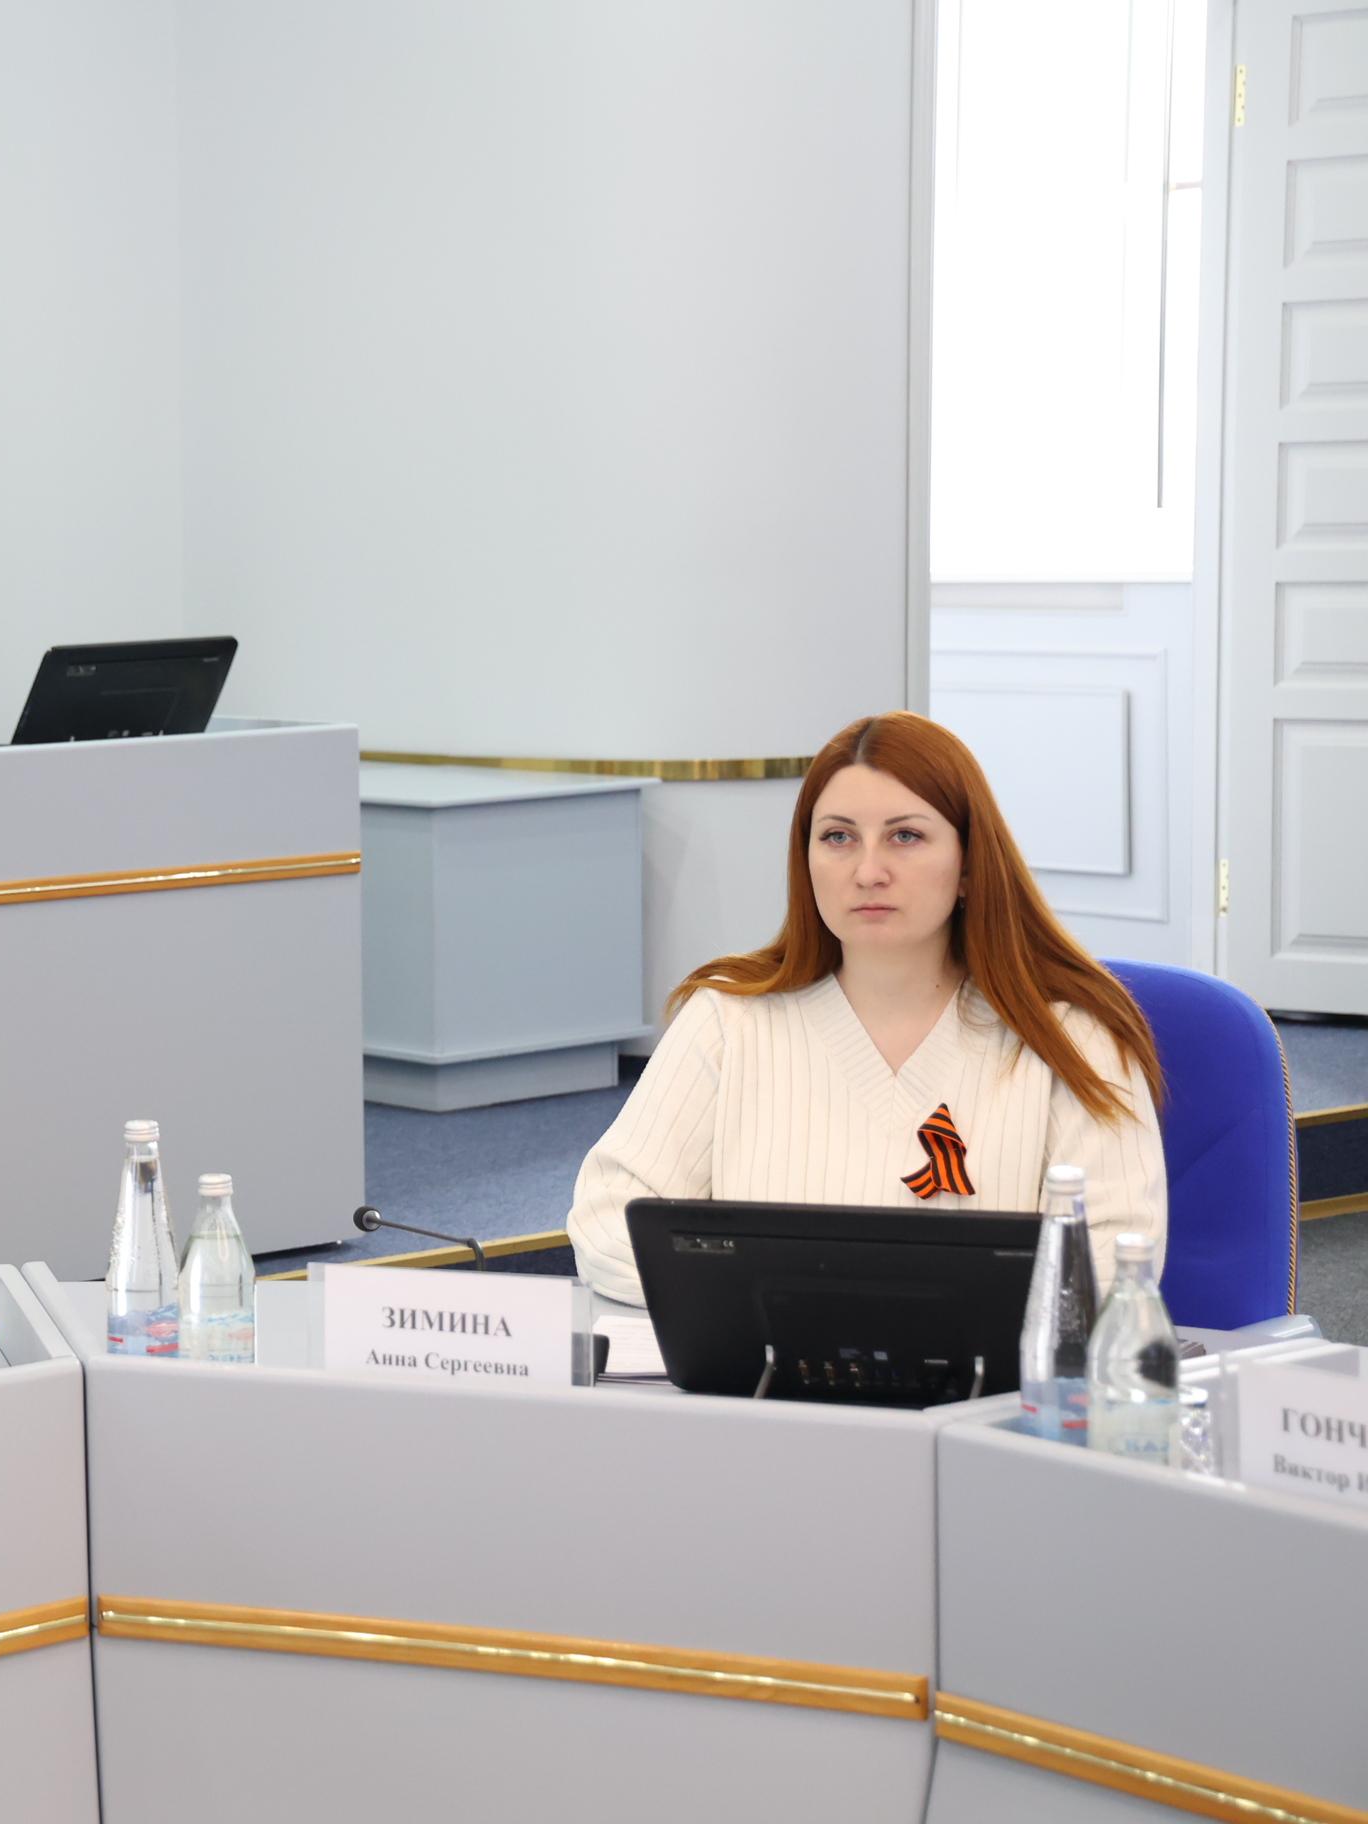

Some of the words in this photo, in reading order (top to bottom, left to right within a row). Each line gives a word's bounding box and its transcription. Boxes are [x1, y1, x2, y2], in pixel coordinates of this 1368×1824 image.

[381, 1306, 512, 1338] ЗИМИНА
[365, 1349, 418, 1368] Анна
[424, 1352, 529, 1377] Сергеевна
[1282, 1407, 1367, 1449] ГОНЧ
[1273, 1453, 1351, 1492] Виктор
